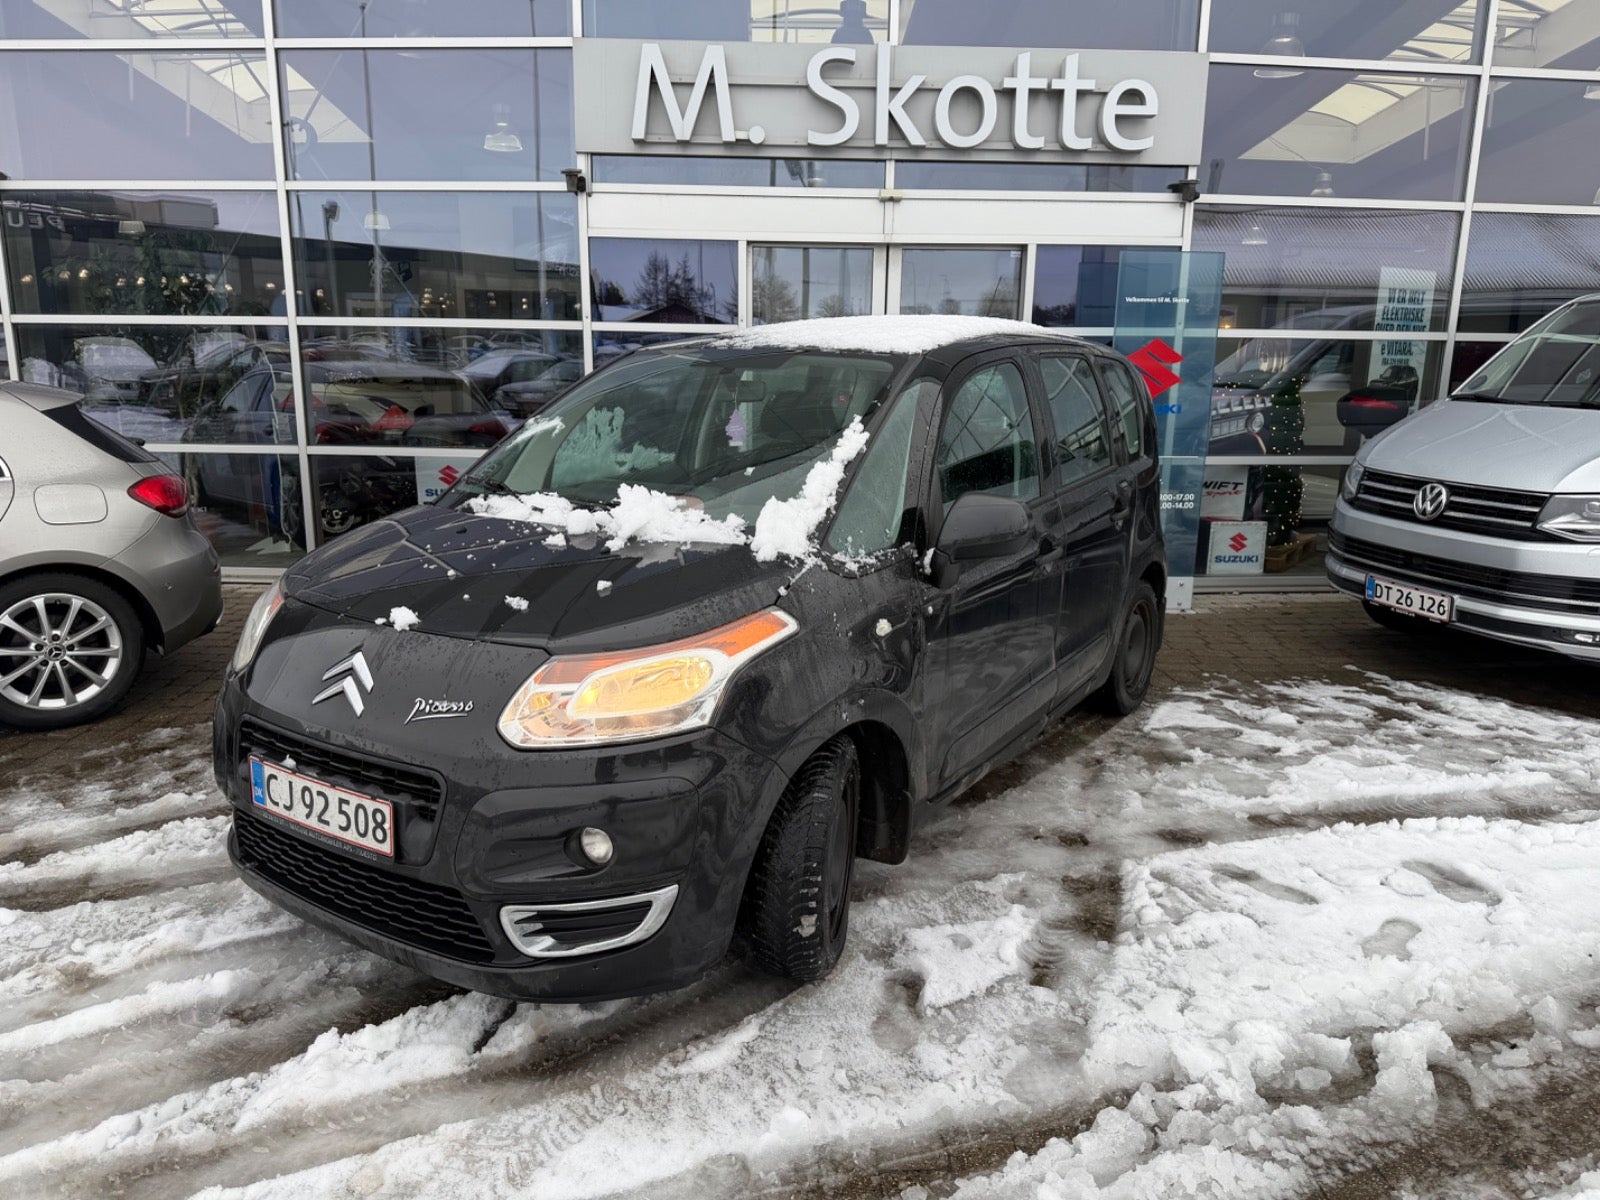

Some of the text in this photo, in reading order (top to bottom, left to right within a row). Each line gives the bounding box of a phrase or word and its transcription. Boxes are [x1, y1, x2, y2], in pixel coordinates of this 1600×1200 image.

[631, 41, 1159, 151] M. Skotte
[1381, 306, 1426, 323] ELEKTRISKE
[1214, 555, 1259, 564] SUZUKI
[1374, 583, 1393, 602] DT
[1395, 589, 1414, 608] 26
[1418, 594, 1446, 616] 126
[404, 697, 474, 725] Picasso
[266, 773, 388, 844] CJ 92 508
